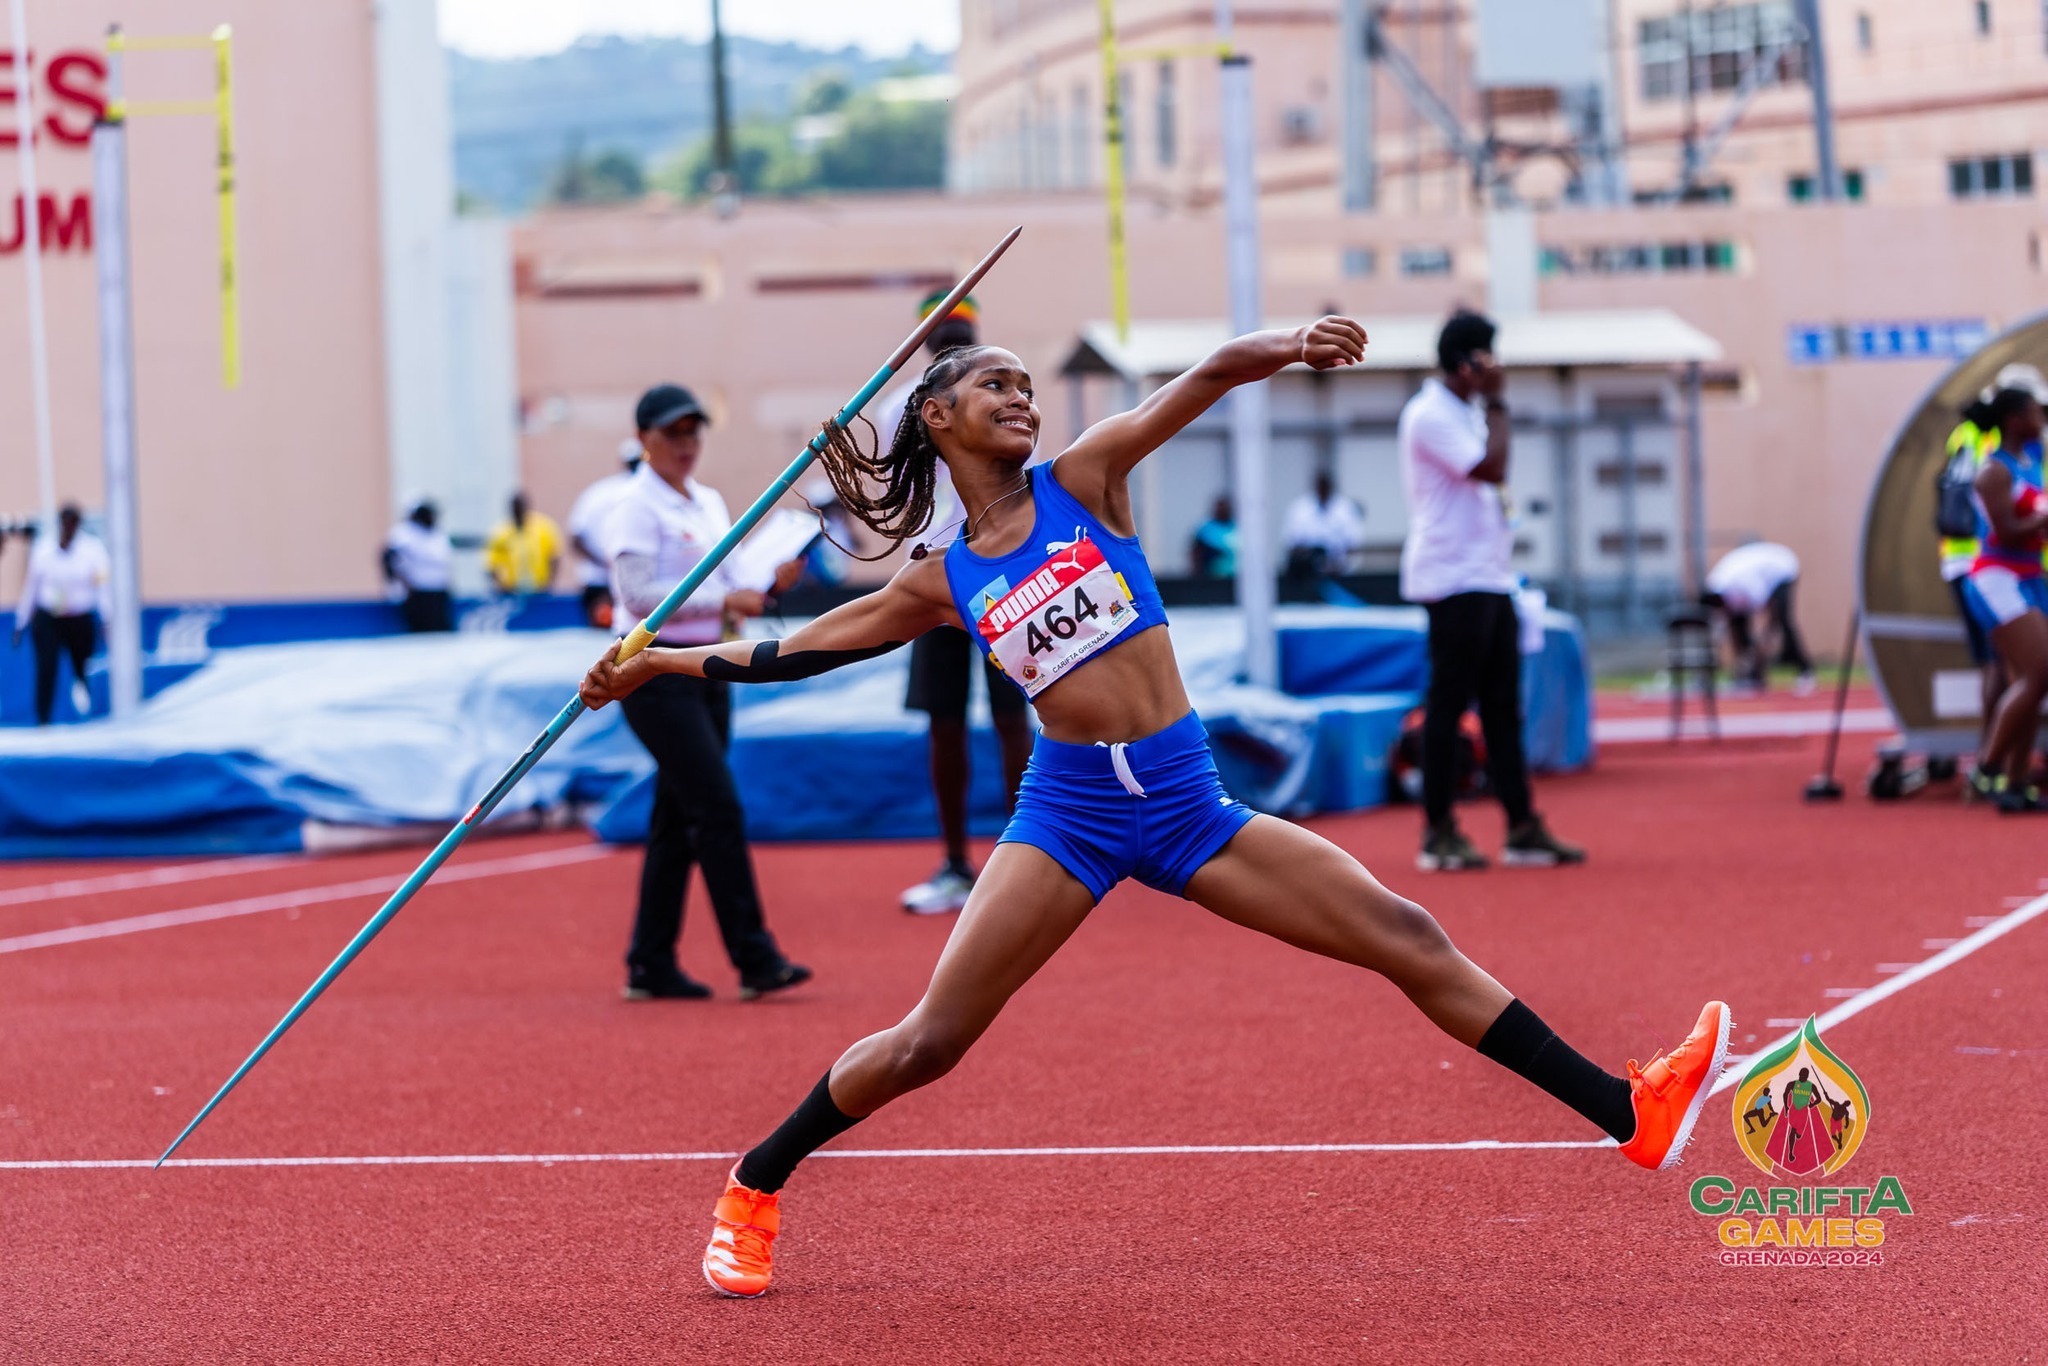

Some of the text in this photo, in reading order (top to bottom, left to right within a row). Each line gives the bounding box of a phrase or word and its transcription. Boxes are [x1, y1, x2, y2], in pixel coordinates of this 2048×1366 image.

[988, 567, 1061, 633] PUMA
[1026, 586, 1099, 657] 464
[1052, 630, 1110, 674] CARIFTA GRENADA
